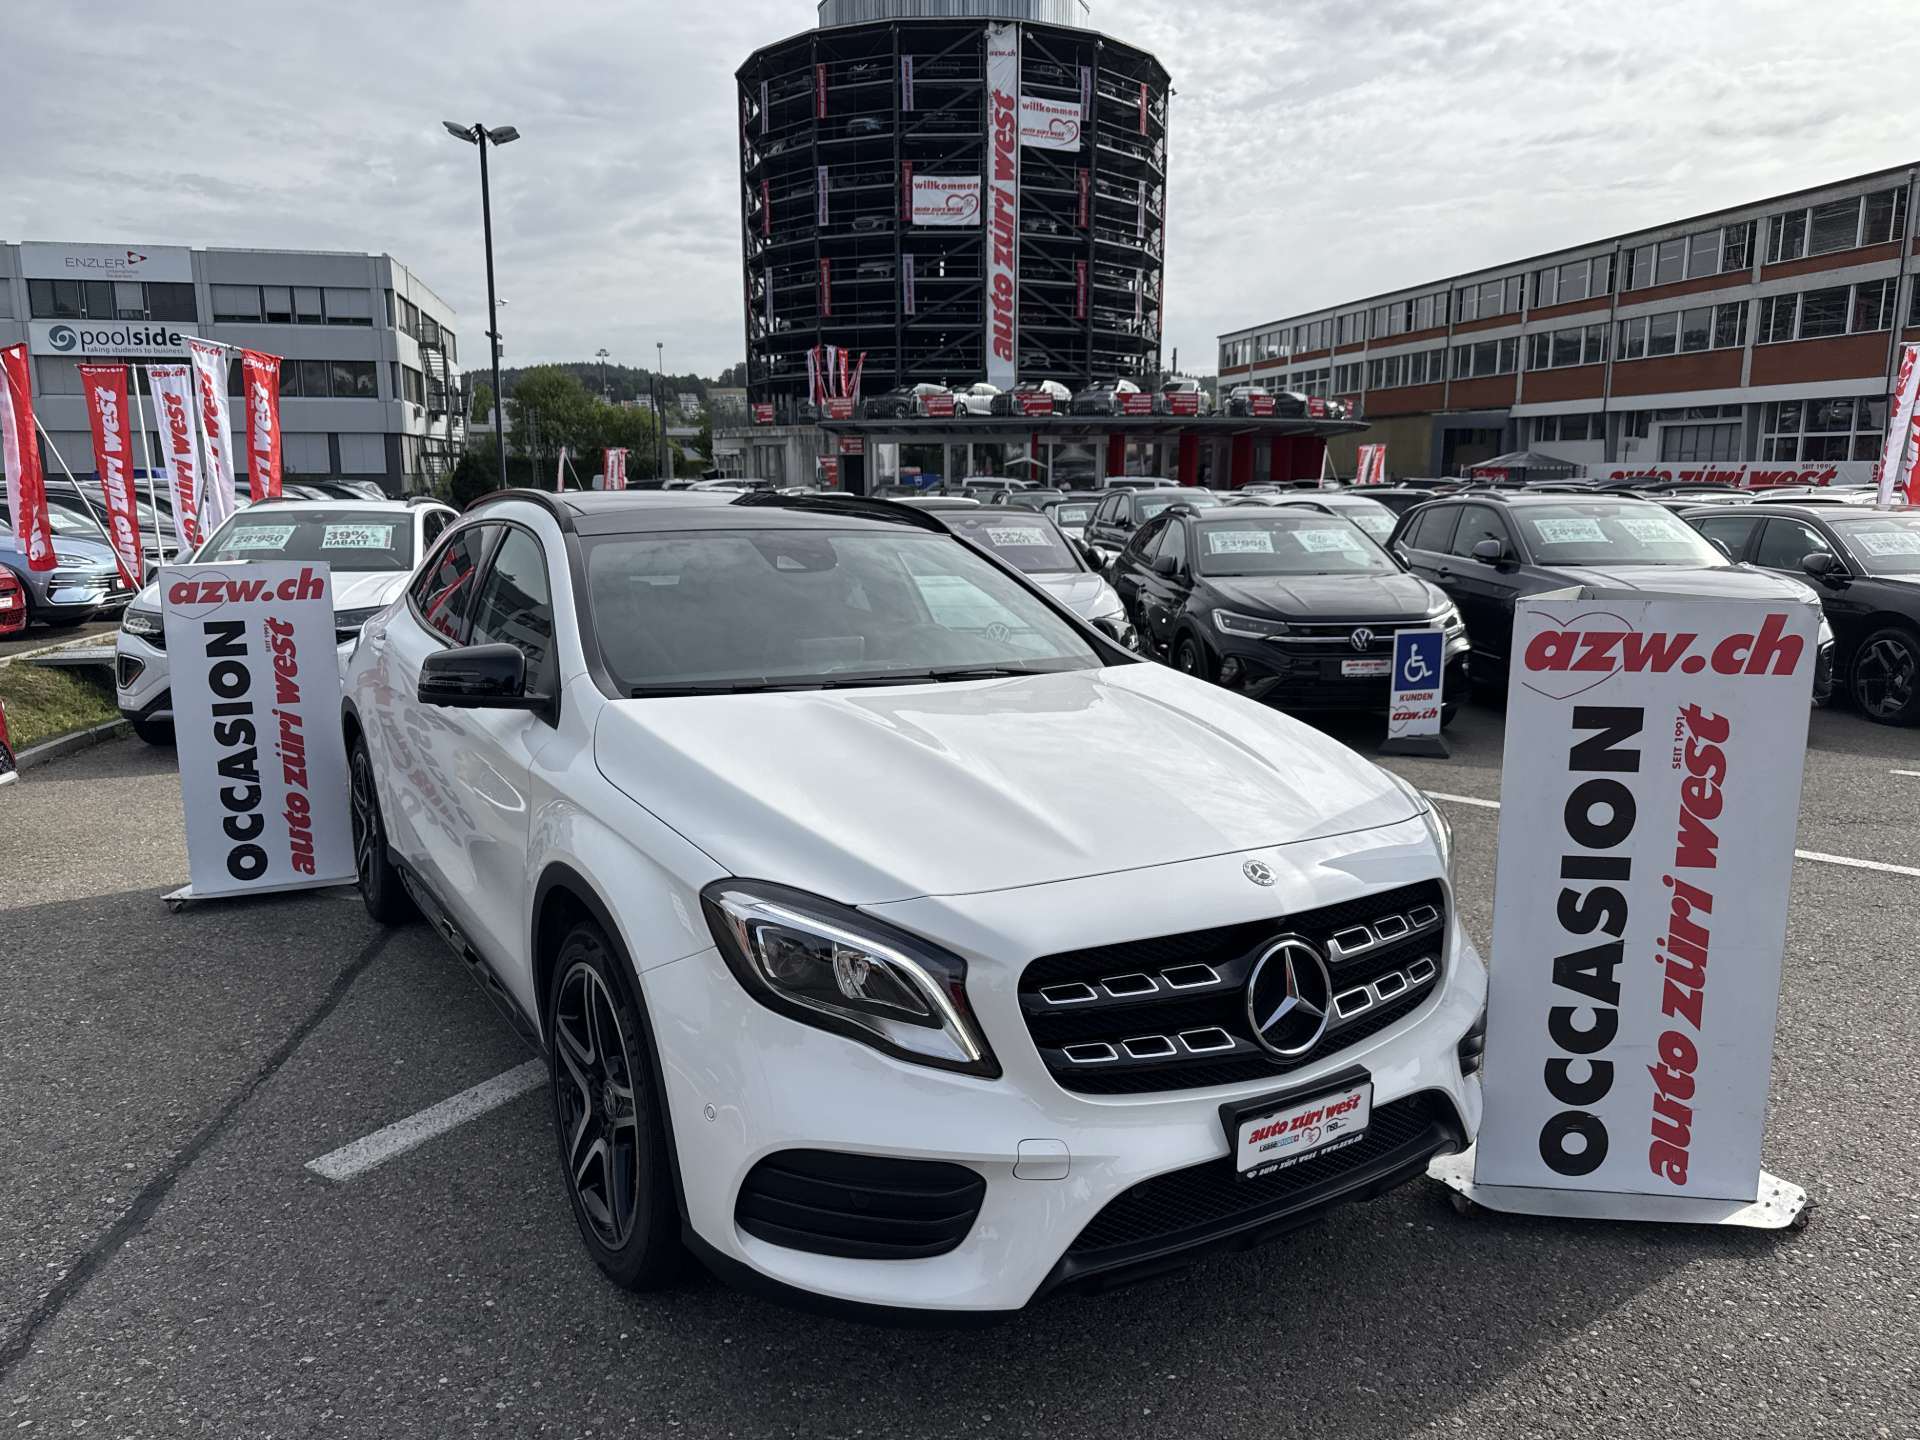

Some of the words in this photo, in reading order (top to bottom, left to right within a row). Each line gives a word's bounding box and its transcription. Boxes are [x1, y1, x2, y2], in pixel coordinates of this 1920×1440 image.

[992, 88, 1016, 181] west
[1022, 101, 1079, 116] willkommen
[914, 180, 979, 190] willkommen
[988, 184, 1015, 273] züri
[64, 257, 126, 269] ENZLER
[80, 326, 182, 352] poolside
[989, 273, 1014, 363] auto
[151, 369, 186, 378] azw.ch
[95, 386, 123, 452] west
[162, 390, 192, 455] west
[101, 454, 129, 515] züri
[171, 457, 197, 517] züri
[326, 530, 369, 541] 39%
[169, 568, 325, 605] azw.ch
[264, 616, 300, 704] west
[1524, 614, 1804, 676] azw.ch
[1392, 707, 1438, 721] azw.ch
[1399, 693, 1434, 702] KUNDEN
[203, 620, 268, 881] OCCASION
[272, 708, 309, 791] züri
[1672, 747, 1683, 770] SEIT
[1674, 716, 1686, 742] 1991
[1675, 702, 1730, 869] west
[281, 792, 316, 876] auto
[1539, 706, 1646, 1177] OCCASION
[1655, 874, 1715, 1031] züri
[1249, 1120, 1289, 1145] auto
[1288, 1106, 1325, 1132] züri
[1325, 1094, 1361, 1119] west
[1646, 1030, 1702, 1186] auto
[1259, 1165, 1279, 1176] auto
[1279, 1156, 1298, 1169] züri
[1299, 1151, 1318, 1163] west
